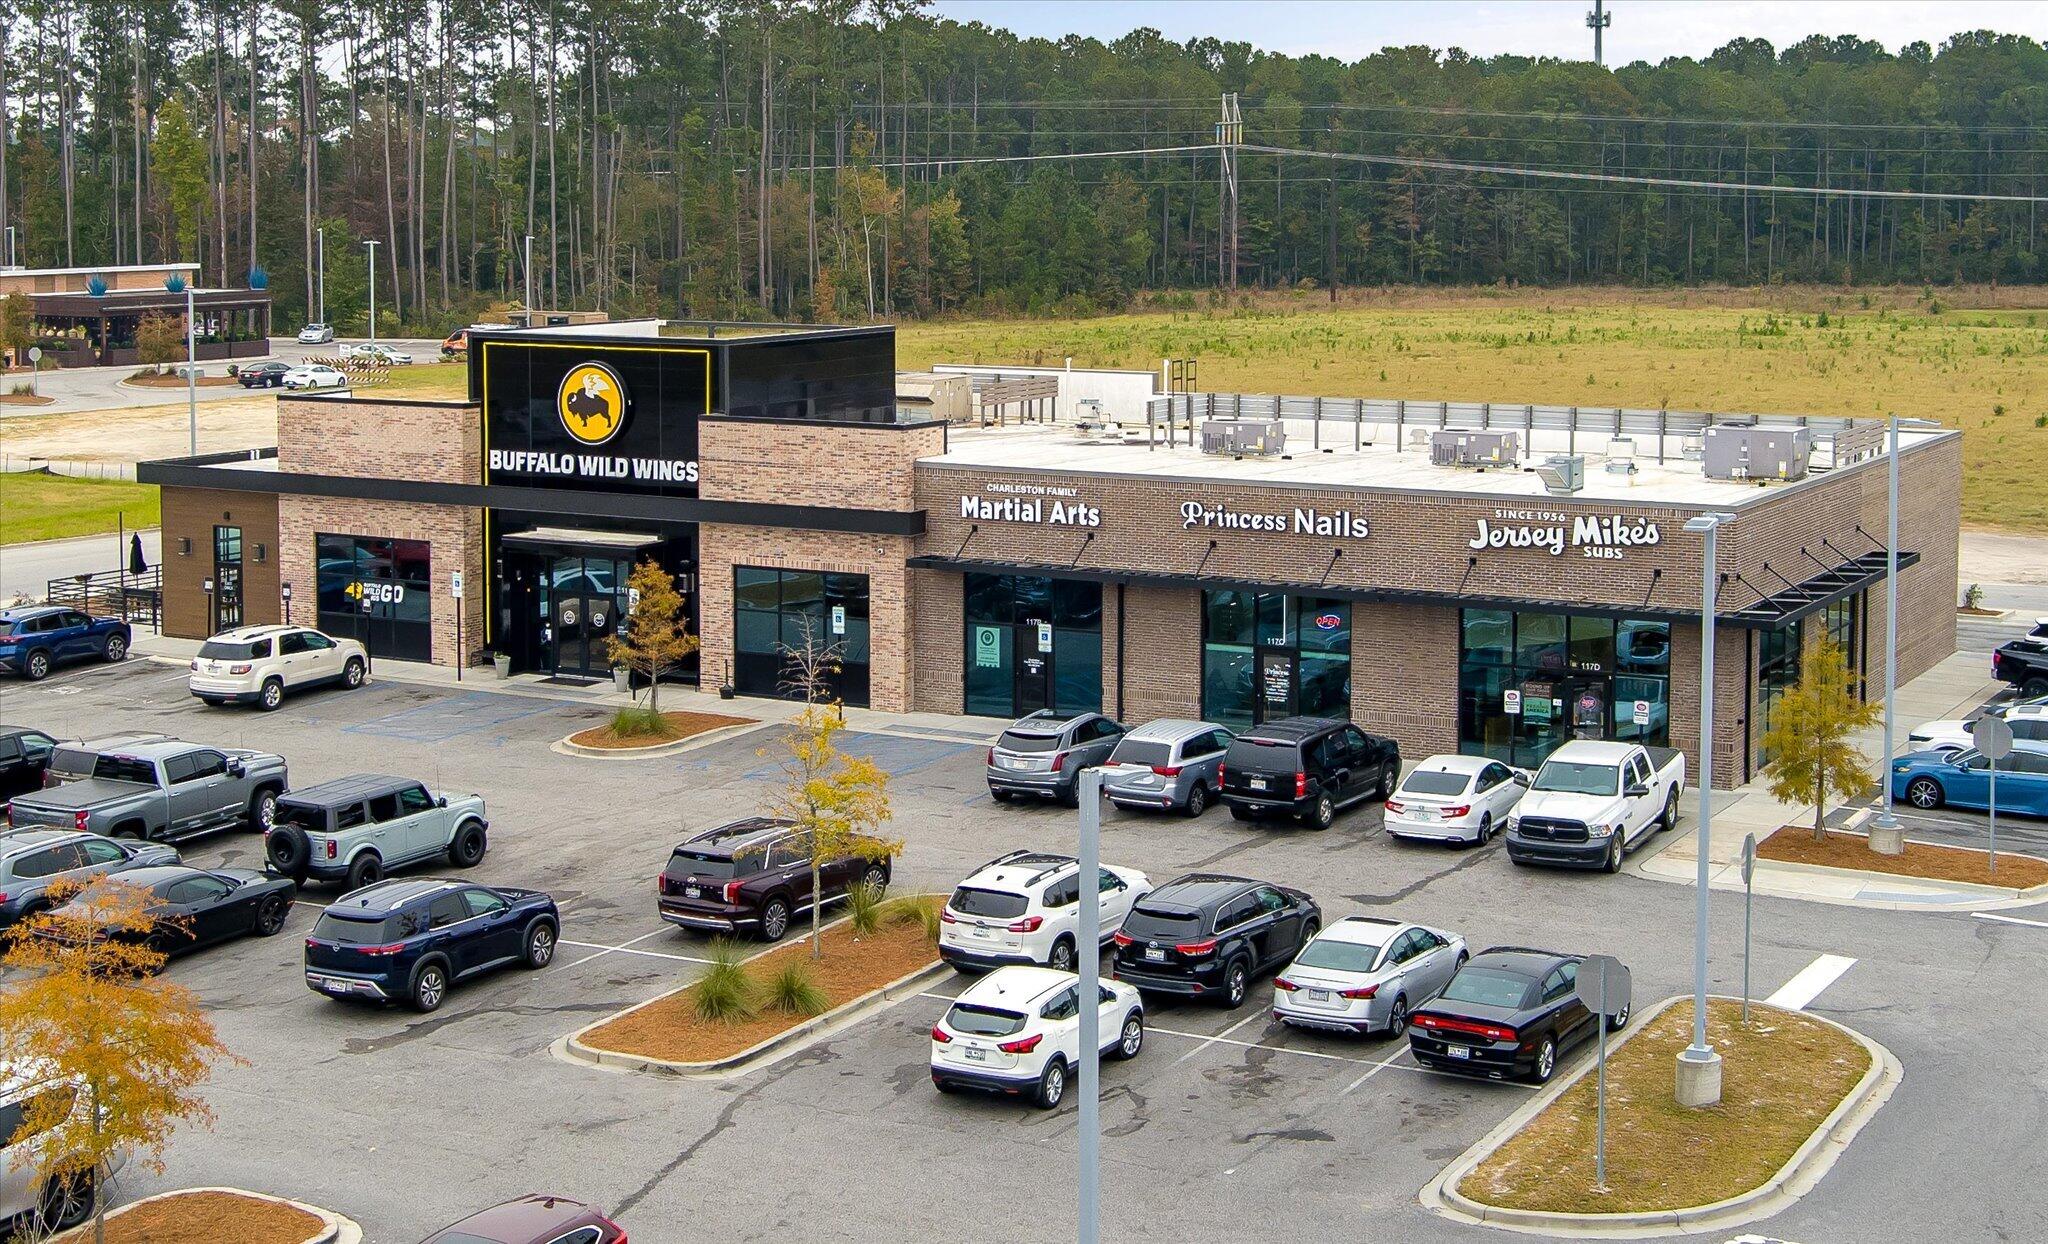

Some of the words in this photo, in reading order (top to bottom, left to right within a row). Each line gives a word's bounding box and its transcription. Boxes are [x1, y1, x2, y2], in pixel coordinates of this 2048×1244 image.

[489, 450, 574, 474] BUFFALO
[577, 455, 628, 478] WILD
[632, 458, 699, 482] WINGS
[986, 483, 1044, 495] CHARLESTON
[1046, 486, 1078, 497] FAMILY
[961, 495, 1042, 523] Martial
[1050, 500, 1100, 527] Arts
[1495, 509, 1533, 520] SINCE
[1537, 511, 1566, 522] 1956
[1180, 501, 1287, 531] Princess
[1294, 508, 1369, 538] Nails
[1468, 519, 1565, 555] Jersey
[1572, 515, 1661, 546] Mike's
[1583, 546, 1623, 559] SUBS
[363, 587, 381, 596] WILD
[380, 584, 404, 604] GO
[1315, 615, 1341, 627] OPEN
[1580, 662, 1601, 671] 117D
